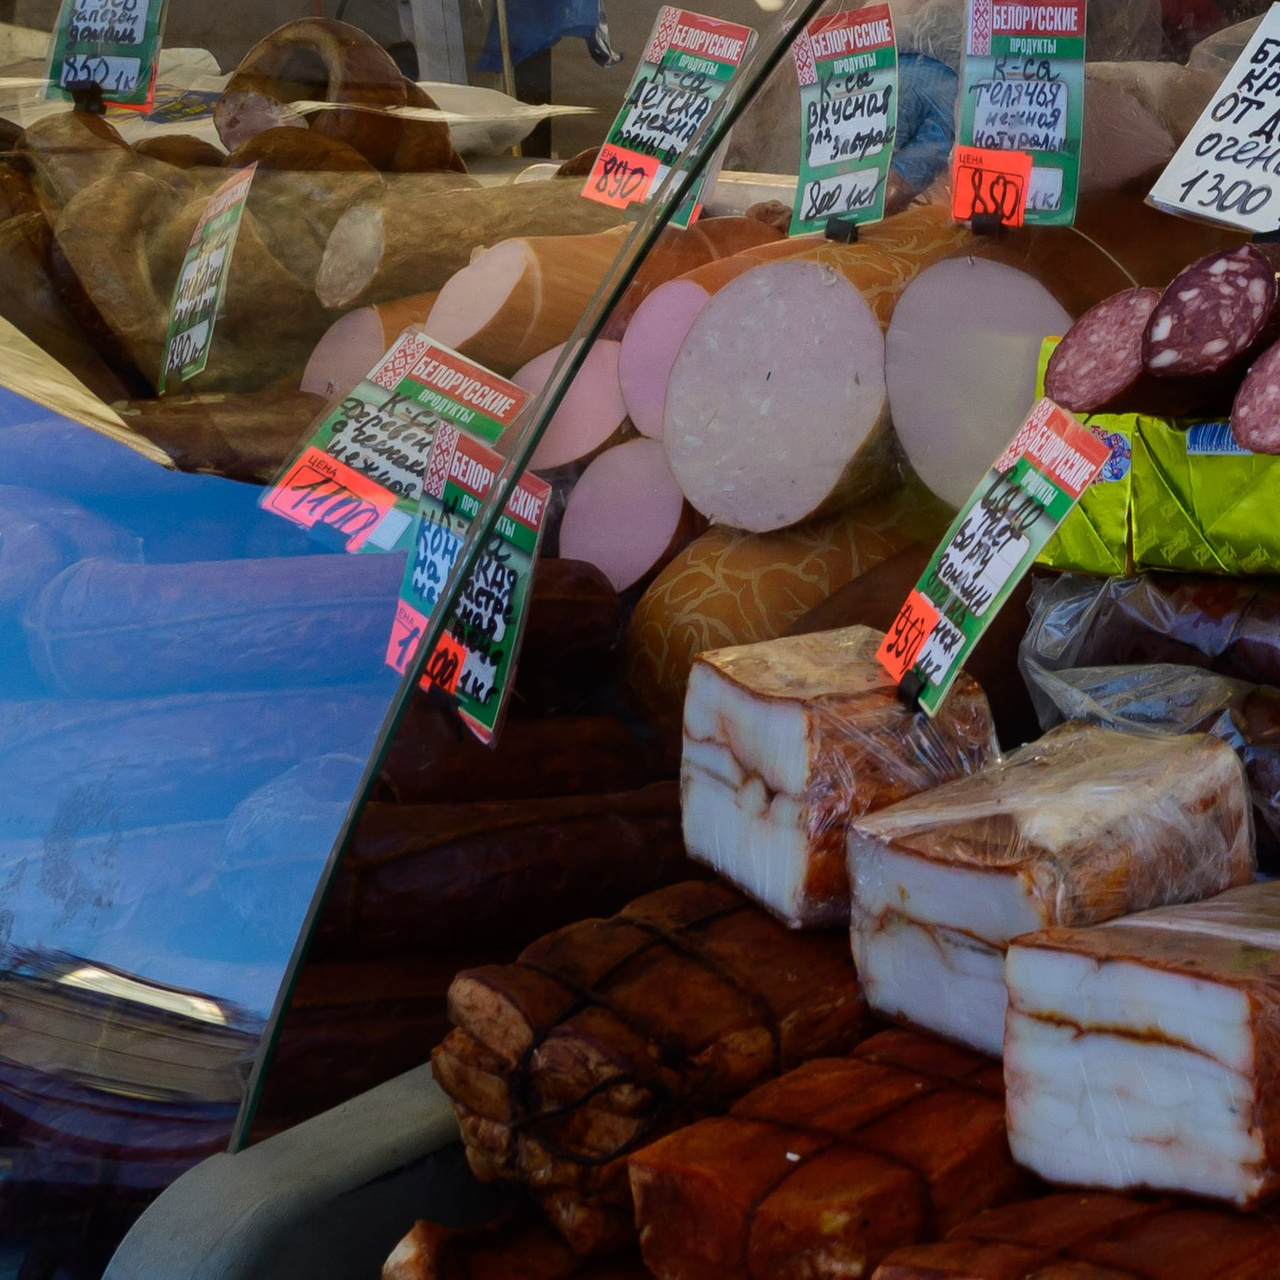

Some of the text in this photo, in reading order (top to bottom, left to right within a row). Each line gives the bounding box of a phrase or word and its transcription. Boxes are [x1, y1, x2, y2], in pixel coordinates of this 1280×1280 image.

[992, 5, 1079, 31] БЕЛОРУССКИЕ
[671, 24, 744, 61] БЕЛОРУССКИЕ
[810, 19, 892, 57] БЕЛОРУССКИЕ
[1009, 38, 1057, 55] ПРОДУКТЫ
[63, 55, 110, 84] 850
[678, 54, 719, 76] ПРОДУКТЫ
[834, 52, 877, 74] ПРОДУКТЫ
[595, 156, 646, 199] 890
[959, 154, 983, 165] ЦЕНА
[805, 180, 842, 219] 800
[971, 169, 1020, 220] 850
[1179, 169, 1273, 216] 1300
[411, 357, 517, 419] БЕЛОРУССКИЕ
[418, 388, 475, 424] ПРОДУКТЫ
[308, 454, 337, 479] ЦЕНА
[1029, 425, 1095, 492] БЕЛОРУССКИЕ
